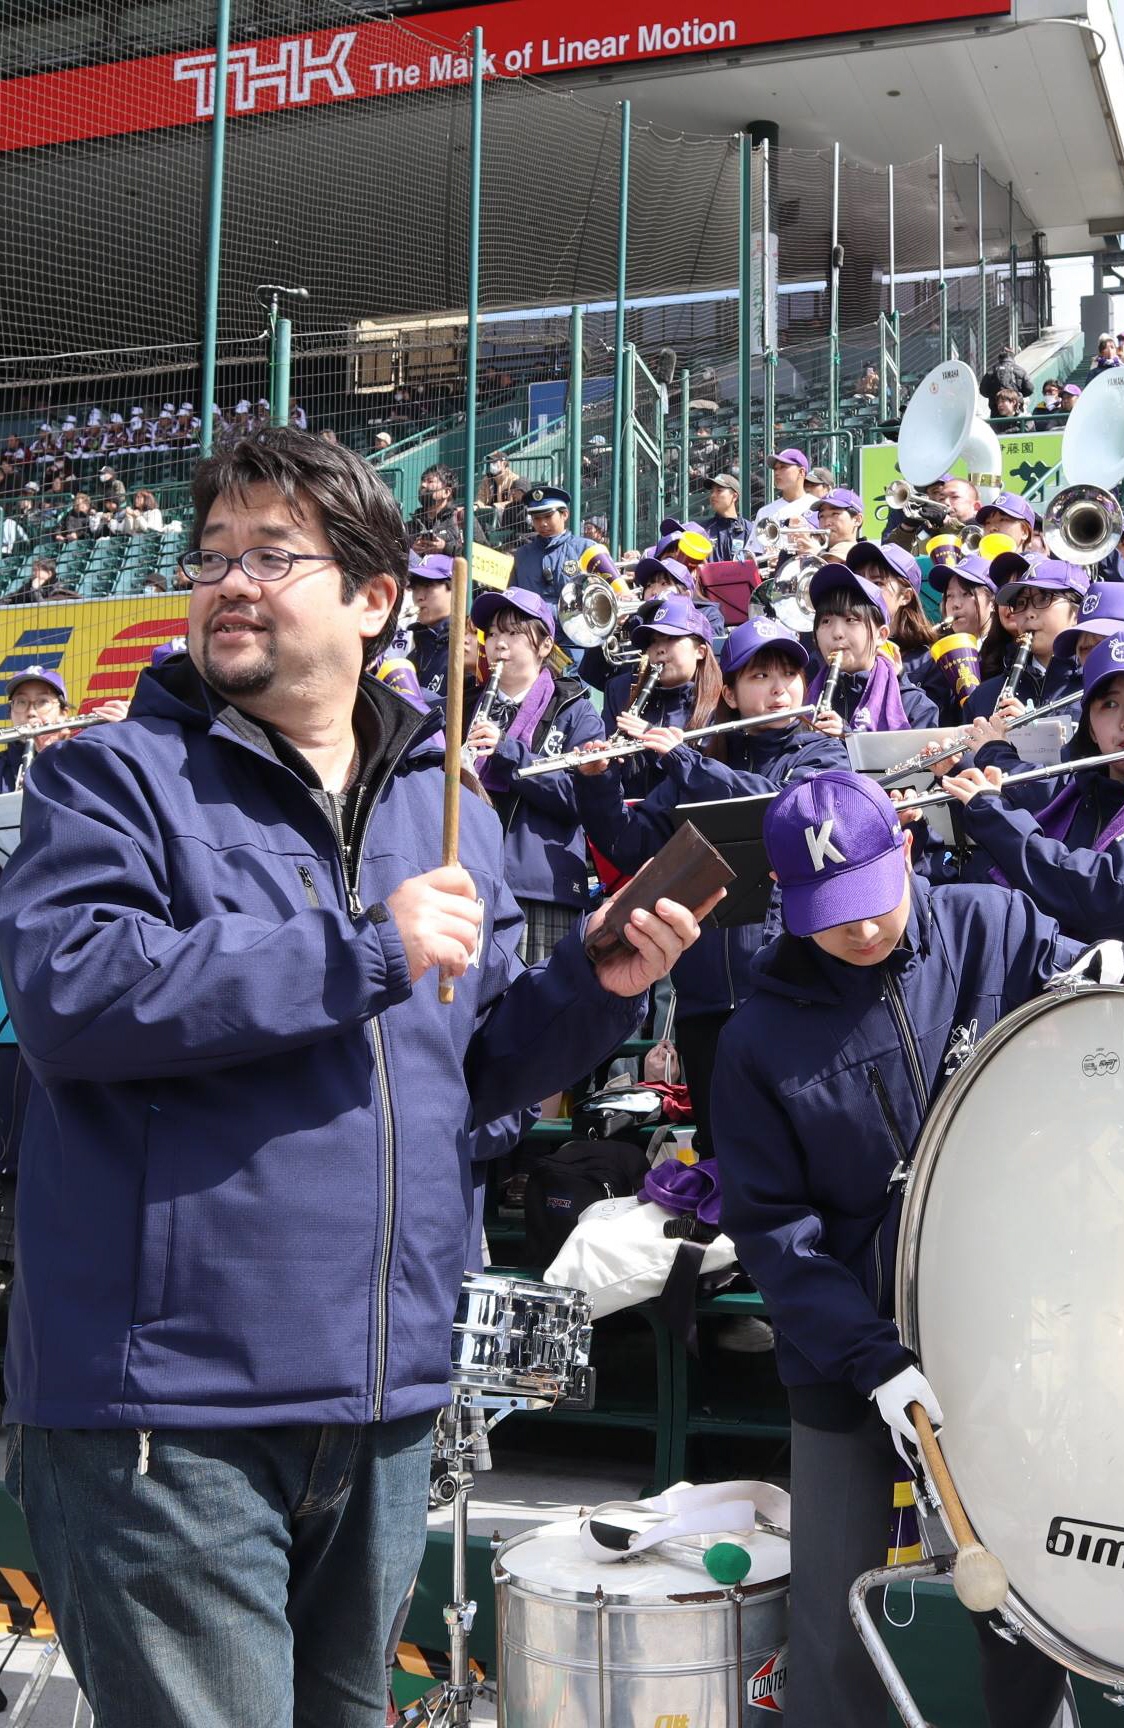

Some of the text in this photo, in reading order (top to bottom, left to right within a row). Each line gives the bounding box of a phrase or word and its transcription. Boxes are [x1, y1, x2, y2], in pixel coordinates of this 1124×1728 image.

[174, 32, 358, 117] THK
[369, 62, 421, 90] The
[505, 42, 533, 71] of
[541, 33, 630, 66] Linear
[637, 18, 736, 53] Motion
[942, 369, 959, 380] YAMAHA
[804, 819, 847, 873] K
